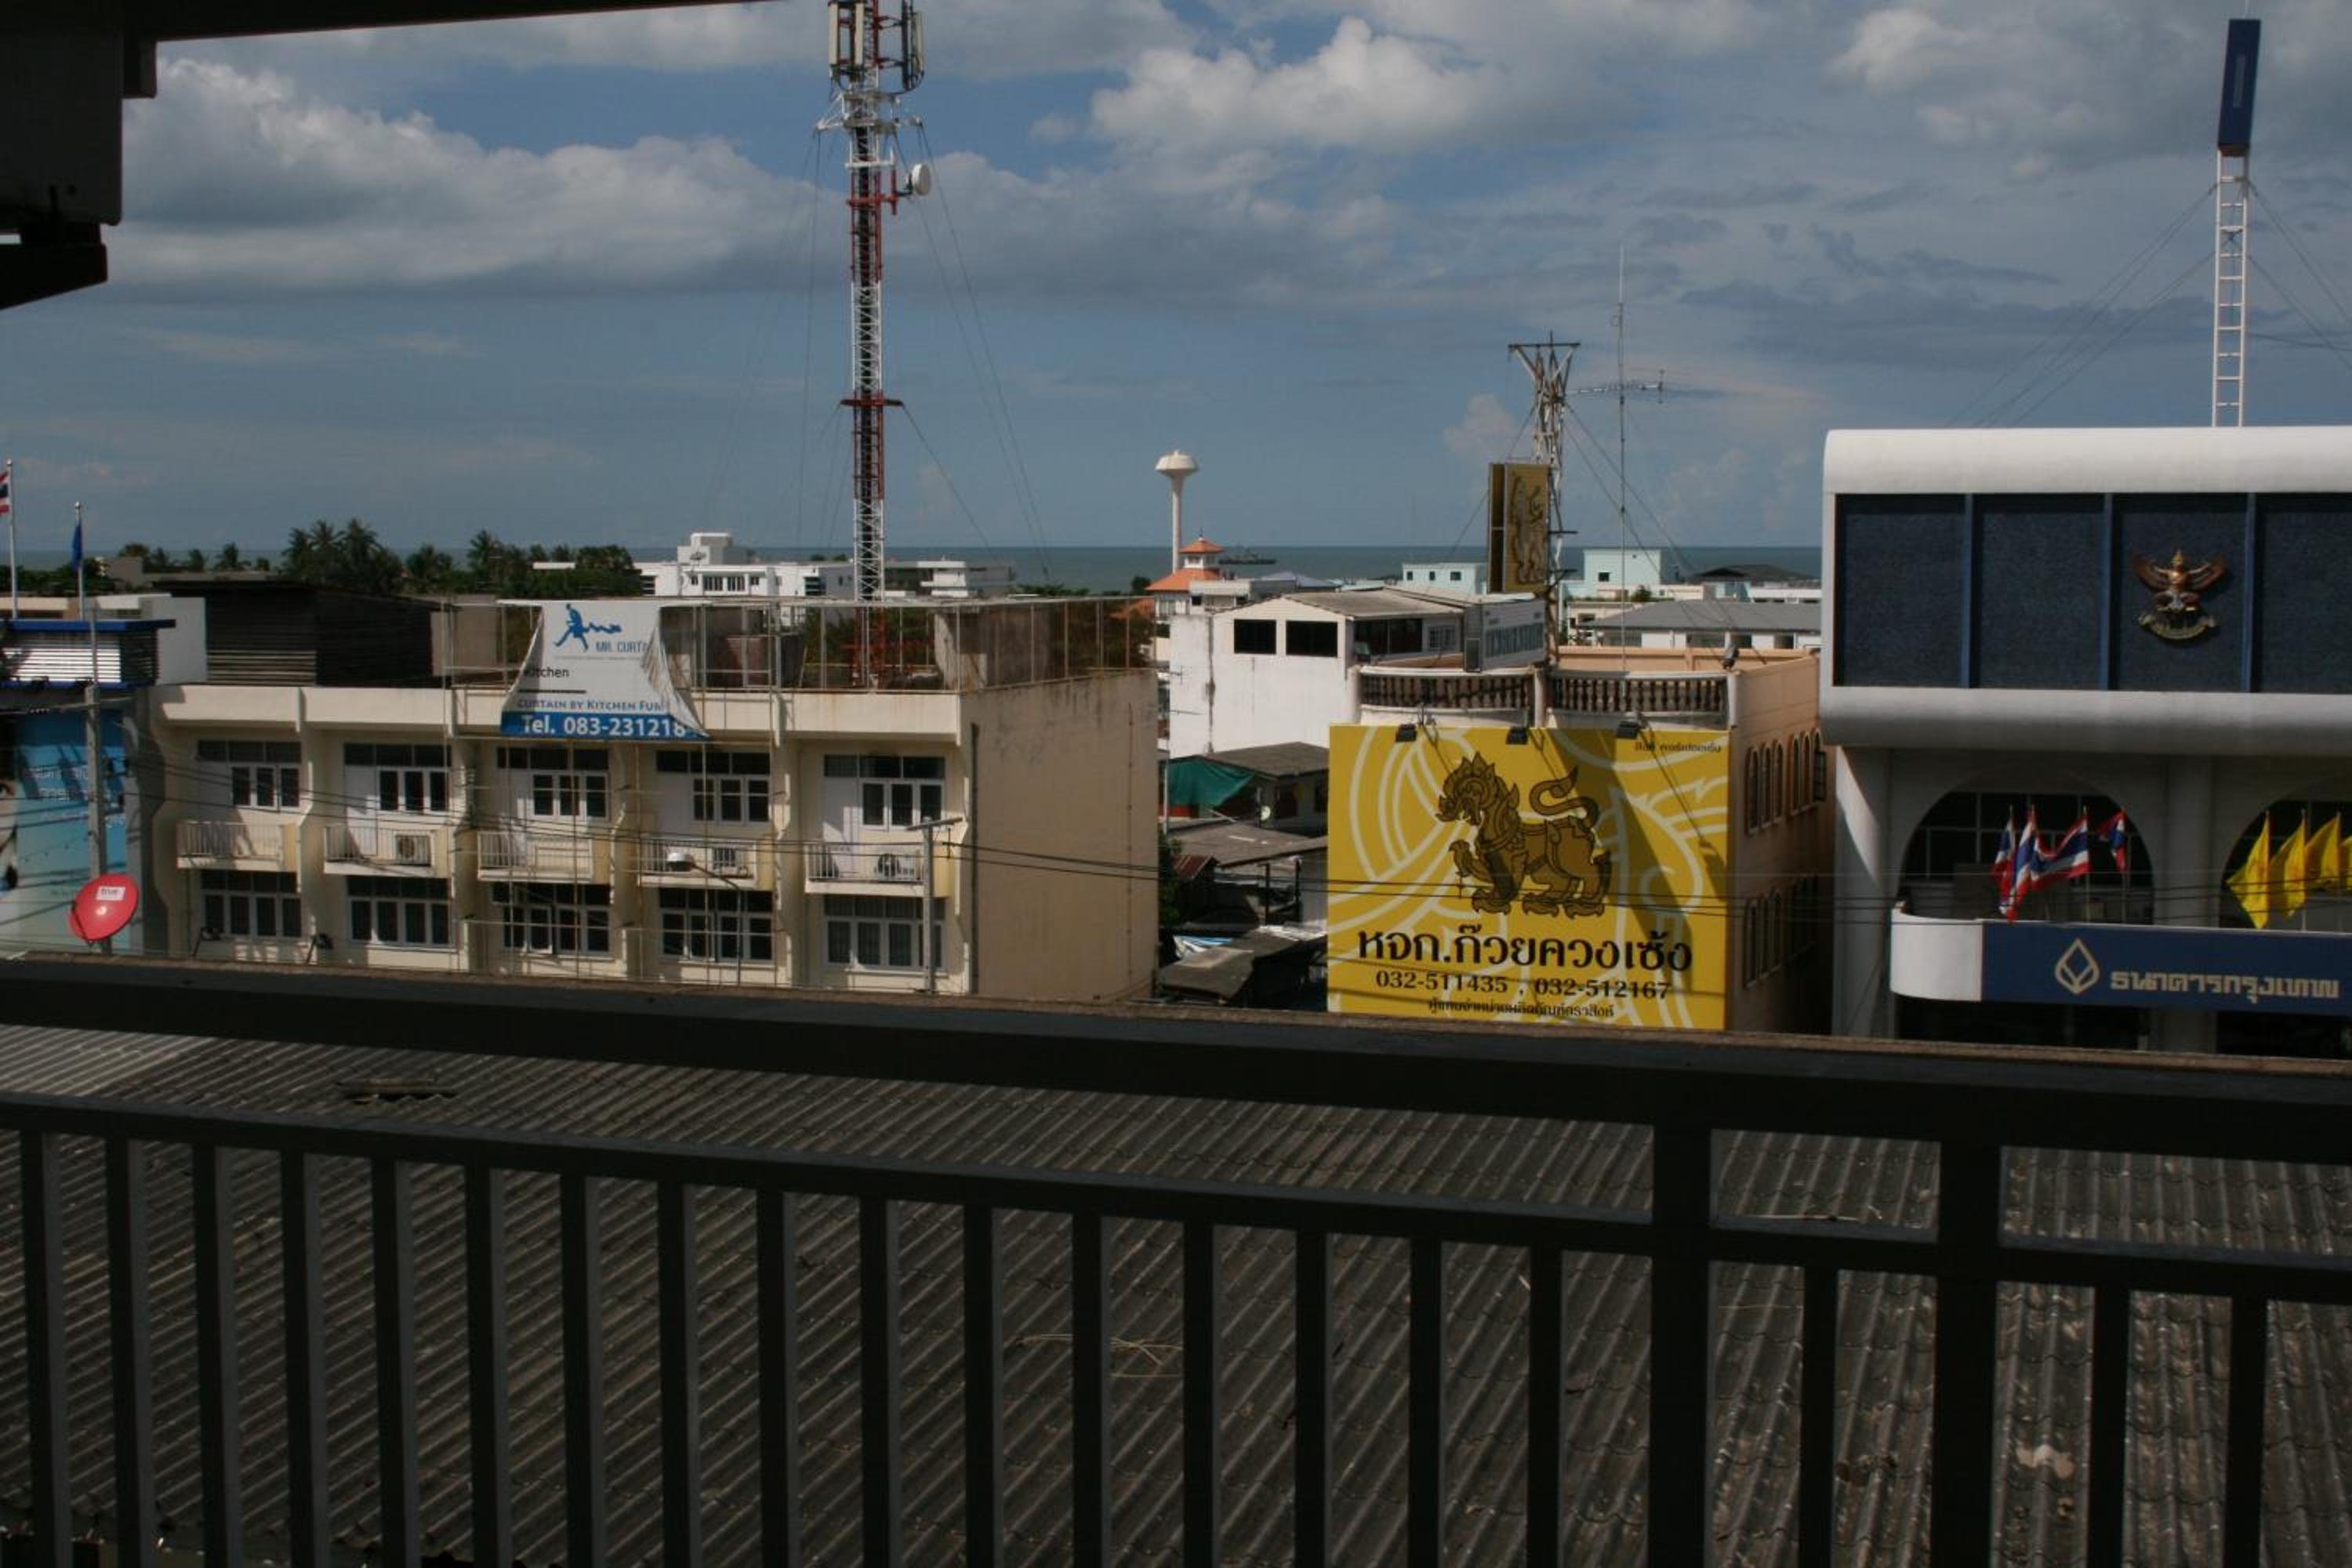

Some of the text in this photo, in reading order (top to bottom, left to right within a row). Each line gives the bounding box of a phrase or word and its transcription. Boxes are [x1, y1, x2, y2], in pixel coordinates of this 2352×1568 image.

[521, 714, 556, 734] Tel.
[1376, 970, 1508, 993] 032-511435
[1535, 977, 1671, 1000] 032-512167
[2111, 970, 2340, 1004] ธนาคารกรุงเทพ
